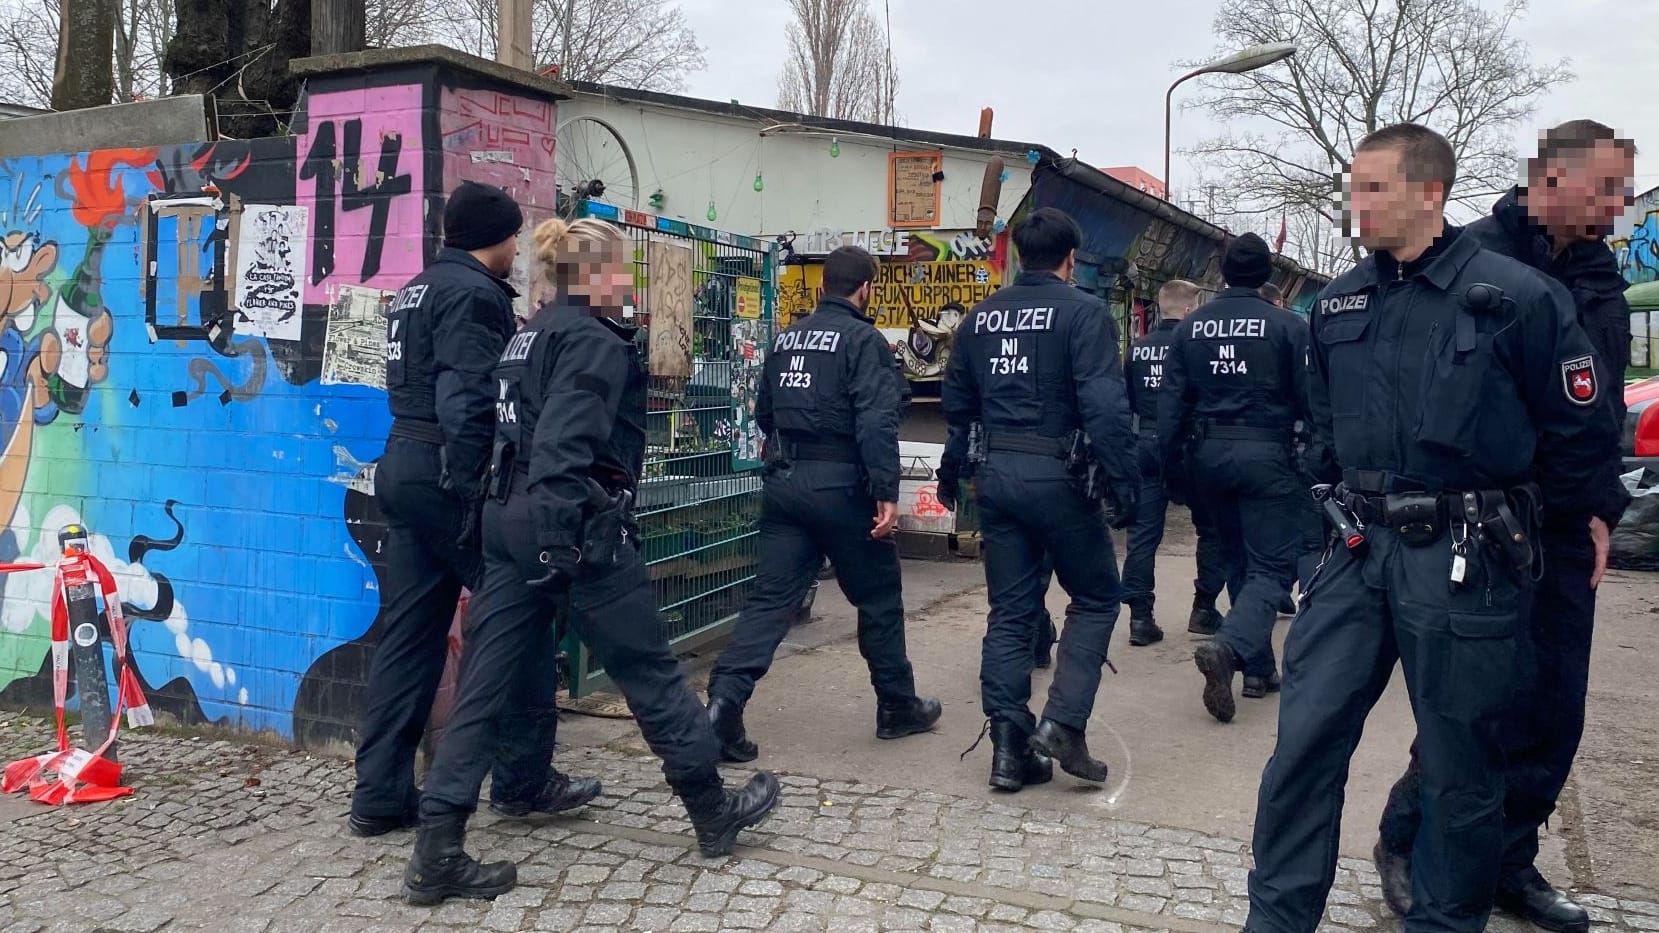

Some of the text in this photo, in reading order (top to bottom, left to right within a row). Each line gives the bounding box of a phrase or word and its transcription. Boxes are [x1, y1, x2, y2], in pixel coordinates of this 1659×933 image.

[300, 118, 411, 287] 14
[975, 307, 1054, 334] POLIZEI
[1192, 319, 1266, 338] POLIZEI
[774, 330, 840, 353] POLIZEI
[1001, 338, 1018, 356] NI
[1219, 345, 1235, 359] NI
[789, 355, 805, 371] NI
[990, 356, 1029, 375] 7314
[1150, 364, 1163, 376] NI
[1210, 361, 1248, 375] 7314
[779, 372, 811, 388] 7323
